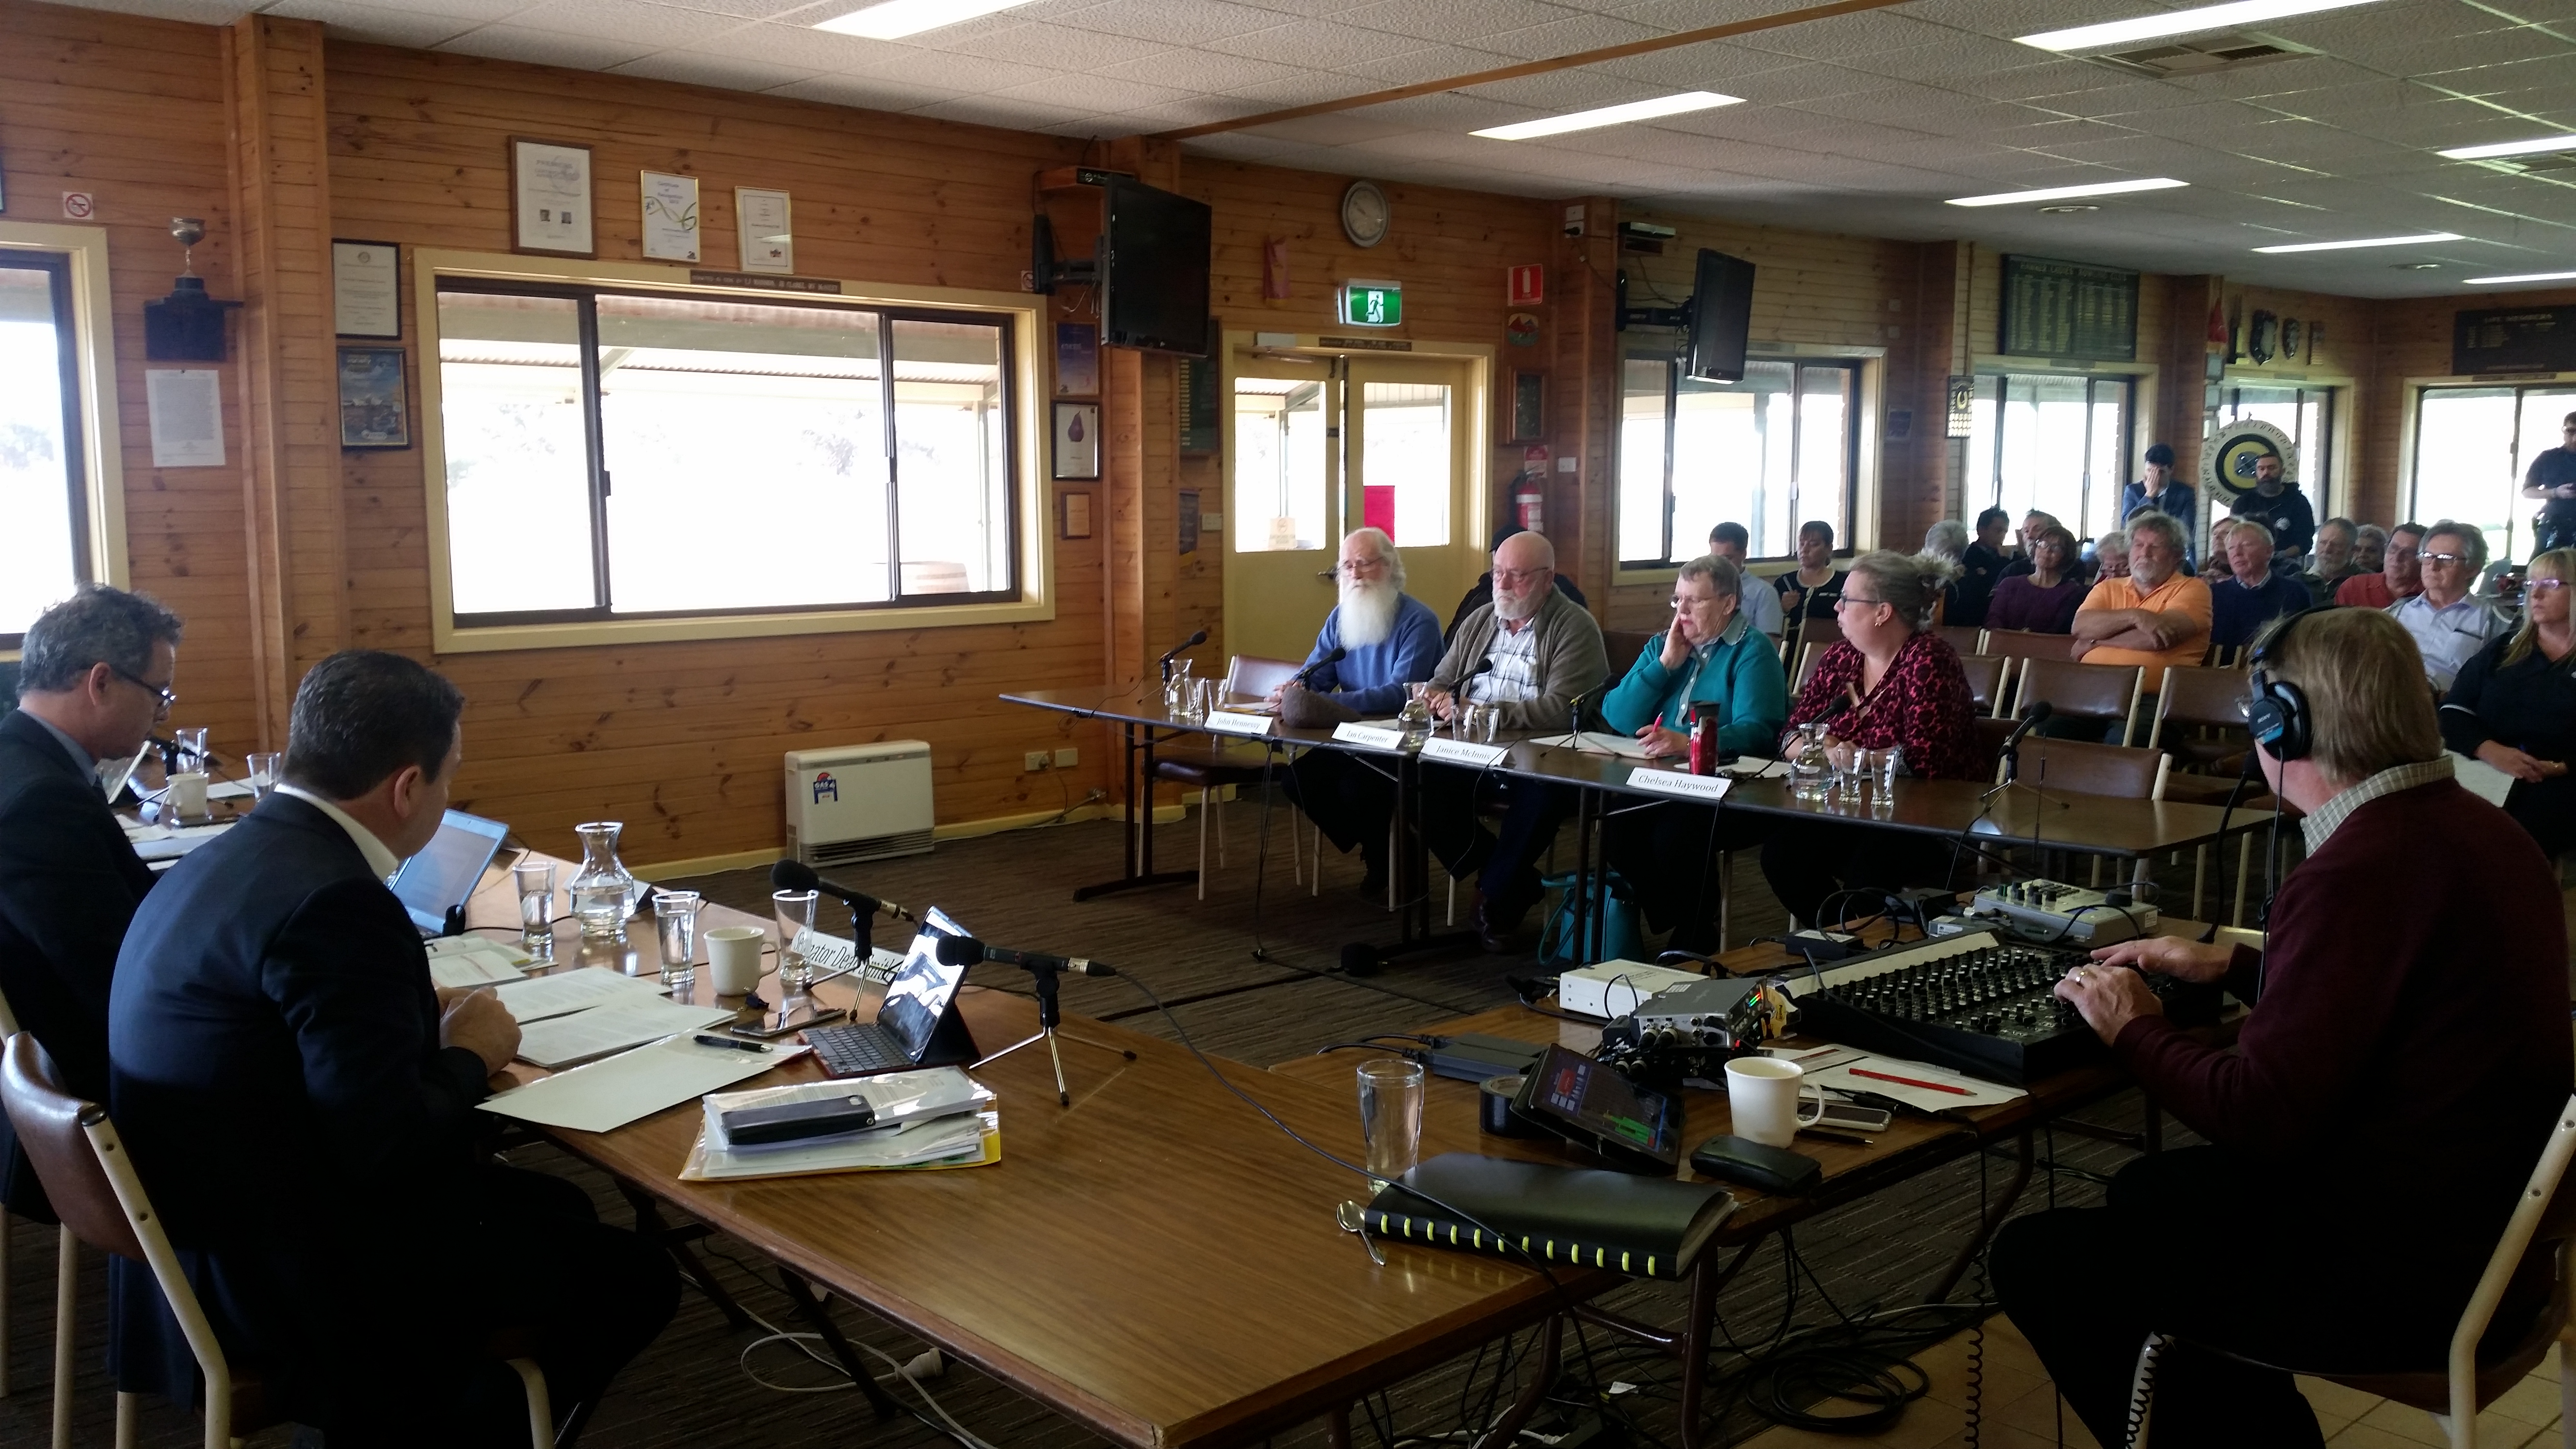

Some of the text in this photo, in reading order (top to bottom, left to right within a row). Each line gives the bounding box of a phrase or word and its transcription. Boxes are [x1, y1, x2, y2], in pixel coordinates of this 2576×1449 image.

[1216, 717, 1261, 731] John Hennessy
[2257, 713, 2270, 724] SONY
[1358, 732, 1388, 743] Carpenter
[1435, 745, 1490, 759] Janice McInnis
[1638, 774, 1719, 792] Chelsea Haywood
[794, 932, 836, 965] Senator
